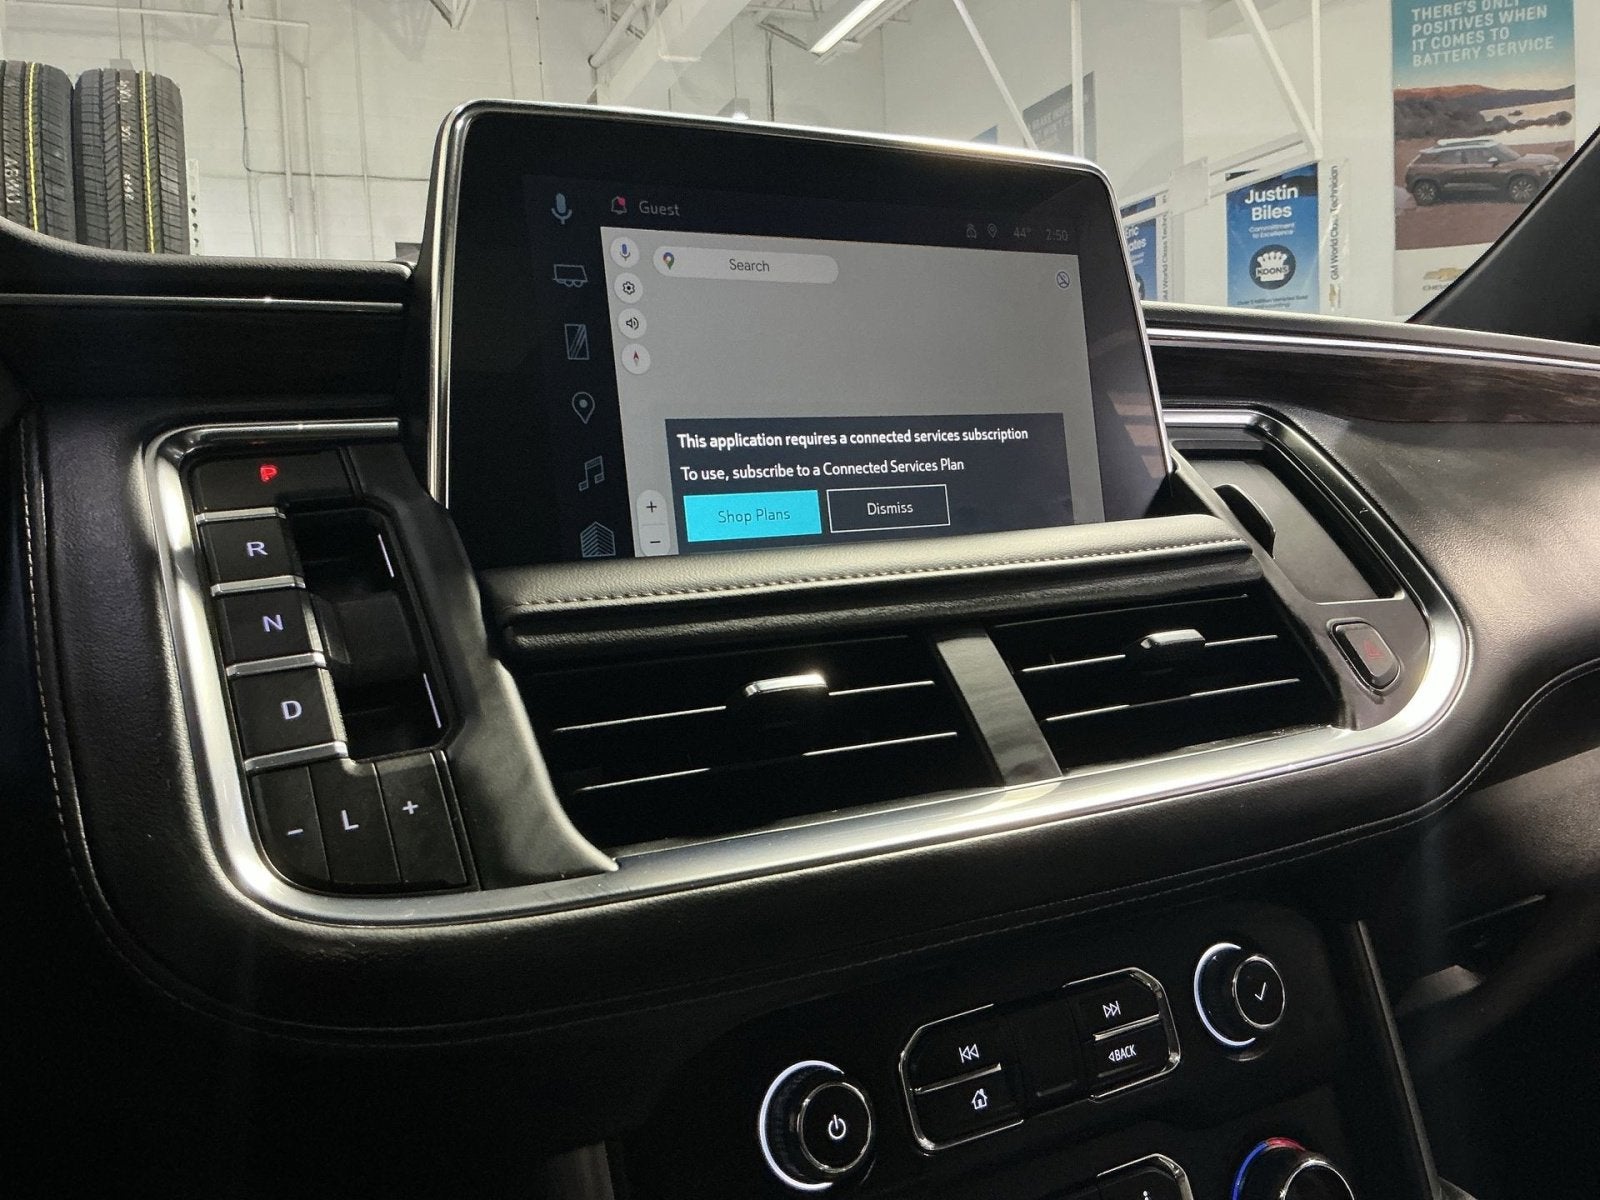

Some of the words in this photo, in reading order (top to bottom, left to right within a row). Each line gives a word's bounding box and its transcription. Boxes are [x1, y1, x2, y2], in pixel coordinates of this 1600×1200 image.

[1411, 1, 1477, 22] THERE'S
[1412, 13, 1494, 37] POSITIVES
[1499, 5, 1547, 24] WHEN
[1412, 38, 1427, 52] IT
[1431, 31, 1485, 49] COMES
[1490, 27, 1510, 41] TO
[1412, 47, 1481, 67] BATTERY
[1487, 36, 1554, 58] SERVICE
[1245, 184, 1299, 204] Justin
[1329, 165, 1339, 214] Technician
[639, 200, 680, 217] Guest
[1252, 205, 1292, 221] Biles
[1045, 228, 1069, 241] 2:50
[1329, 238, 1339, 266] World
[729, 258, 770, 272] Search
[1257, 266, 1289, 276] KOONS
[1330, 266, 1340, 280] GM
[677, 433, 707, 448] This
[709, 432, 783, 451] application
[785, 432, 837, 449] requires
[839, 435, 847, 445] a
[850, 429, 912, 444] connected
[914, 430, 960, 442] services
[962, 428, 1028, 443] subscription
[258, 464, 278, 482] P
[680, 466, 698, 481] To
[701, 468, 729, 482] use,
[732, 463, 794, 479] subscribe
[796, 465, 810, 477] to
[813, 467, 821, 476] a
[823, 460, 888, 476] Connected
[890, 459, 939, 473] Services
[940, 458, 965, 471] Plan
[718, 510, 751, 526] Shop
[756, 508, 791, 521] Plans
[867, 502, 914, 515] Dismiss
[246, 540, 268, 557] R
[263, 614, 285, 633] N
[281, 700, 303, 720] D
[341, 809, 359, 831] L
[1114, 1044, 1137, 1062] BACK
